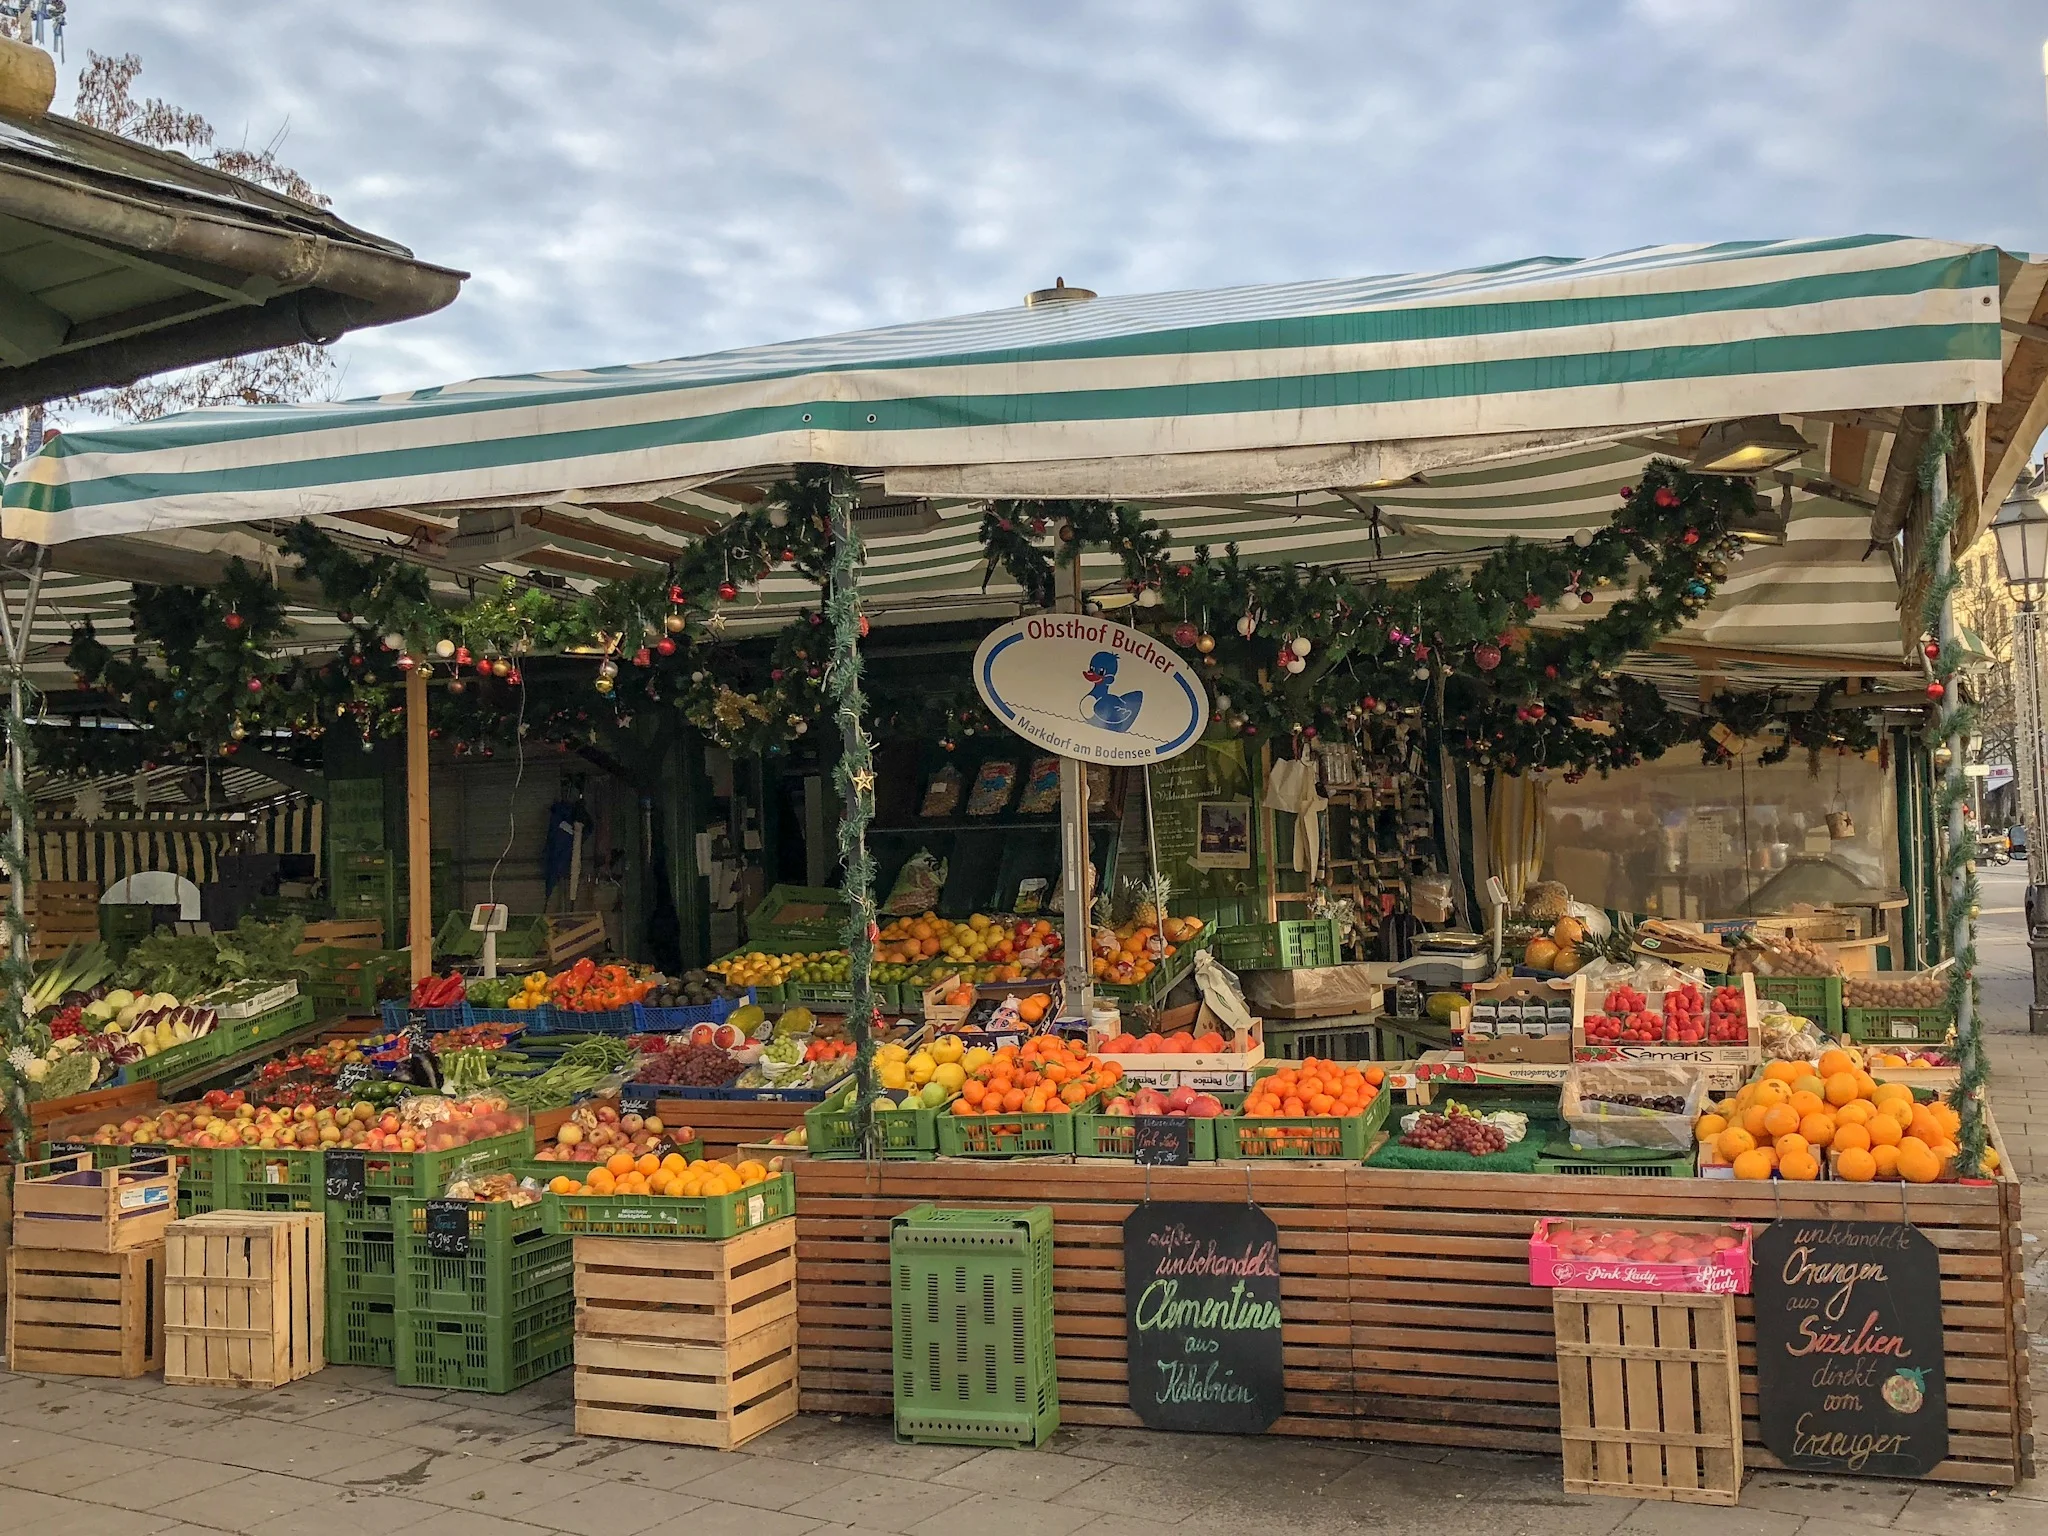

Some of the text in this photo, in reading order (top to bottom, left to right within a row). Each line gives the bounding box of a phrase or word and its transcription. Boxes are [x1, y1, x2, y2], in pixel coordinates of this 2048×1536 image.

[1028, 618, 1175, 673] Obsthof Bucher
[1017, 716, 1151, 760] Markdorf am Bodensee
[1154, 786, 1222, 803] Viktualienmarkt
[1620, 1047, 1714, 1062] Samaris
[1193, 1077, 1222, 1086] Pernice
[1794, 1223, 1911, 1250] unbehandelte
[1585, 1266, 1662, 1287] Pink Lady
[1696, 1266, 1735, 1282] Pink
[1703, 1277, 1739, 1293] Lady
[1782, 1246, 1888, 1321] Orangen
[1136, 1279, 1281, 1331] Clementinen
[1786, 1296, 1819, 1311] aus
[1185, 1336, 1219, 1353] aus
[1786, 1309, 1911, 1357] Sizilien
[1156, 1359, 1256, 1404] Kalabrien
[1812, 1357, 1876, 1388] direkt
[1824, 1393, 1863, 1411] vom
[1793, 1412, 1911, 1470] Erzeuger
